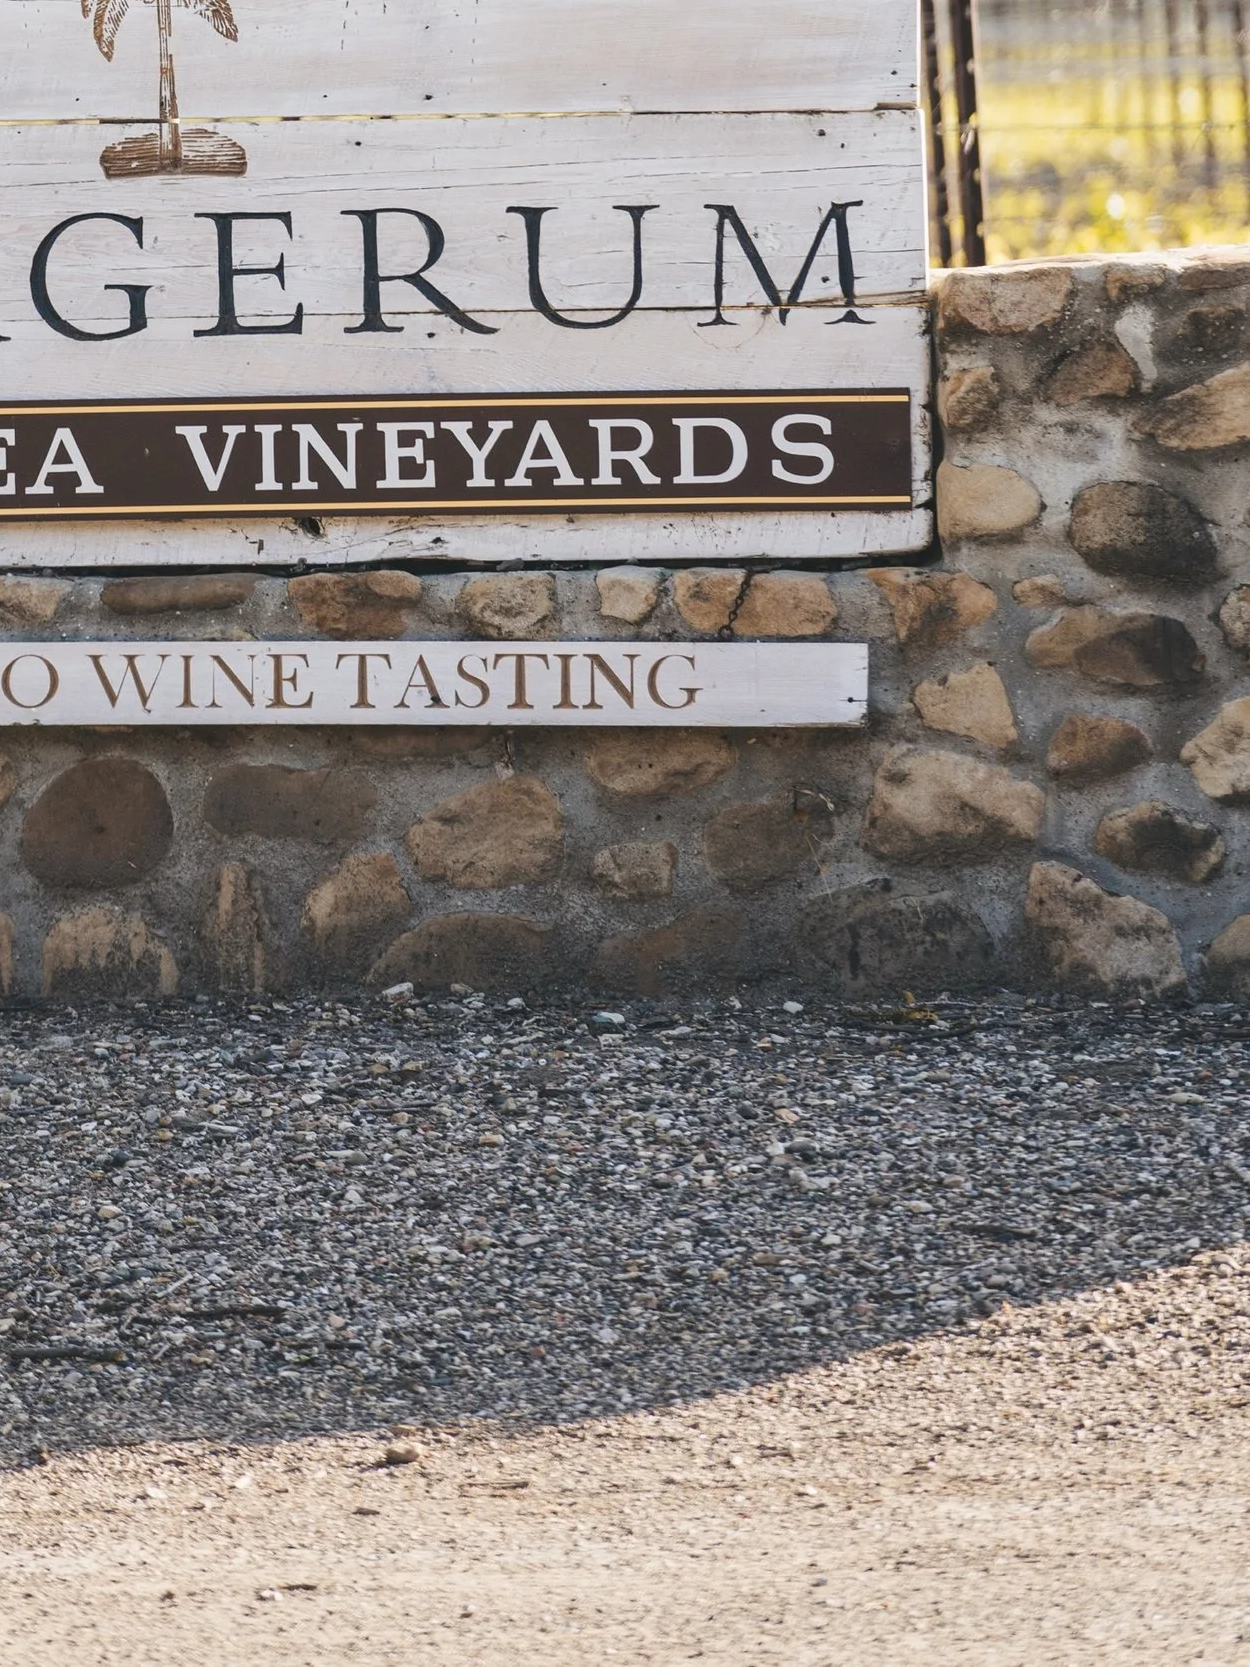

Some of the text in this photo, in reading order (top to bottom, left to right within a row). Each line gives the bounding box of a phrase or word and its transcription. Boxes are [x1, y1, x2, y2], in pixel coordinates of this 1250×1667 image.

[175, 413, 836, 492] VINEYARDS
[88, 653, 314, 712] WINE
[334, 652, 703, 710] TASTING
